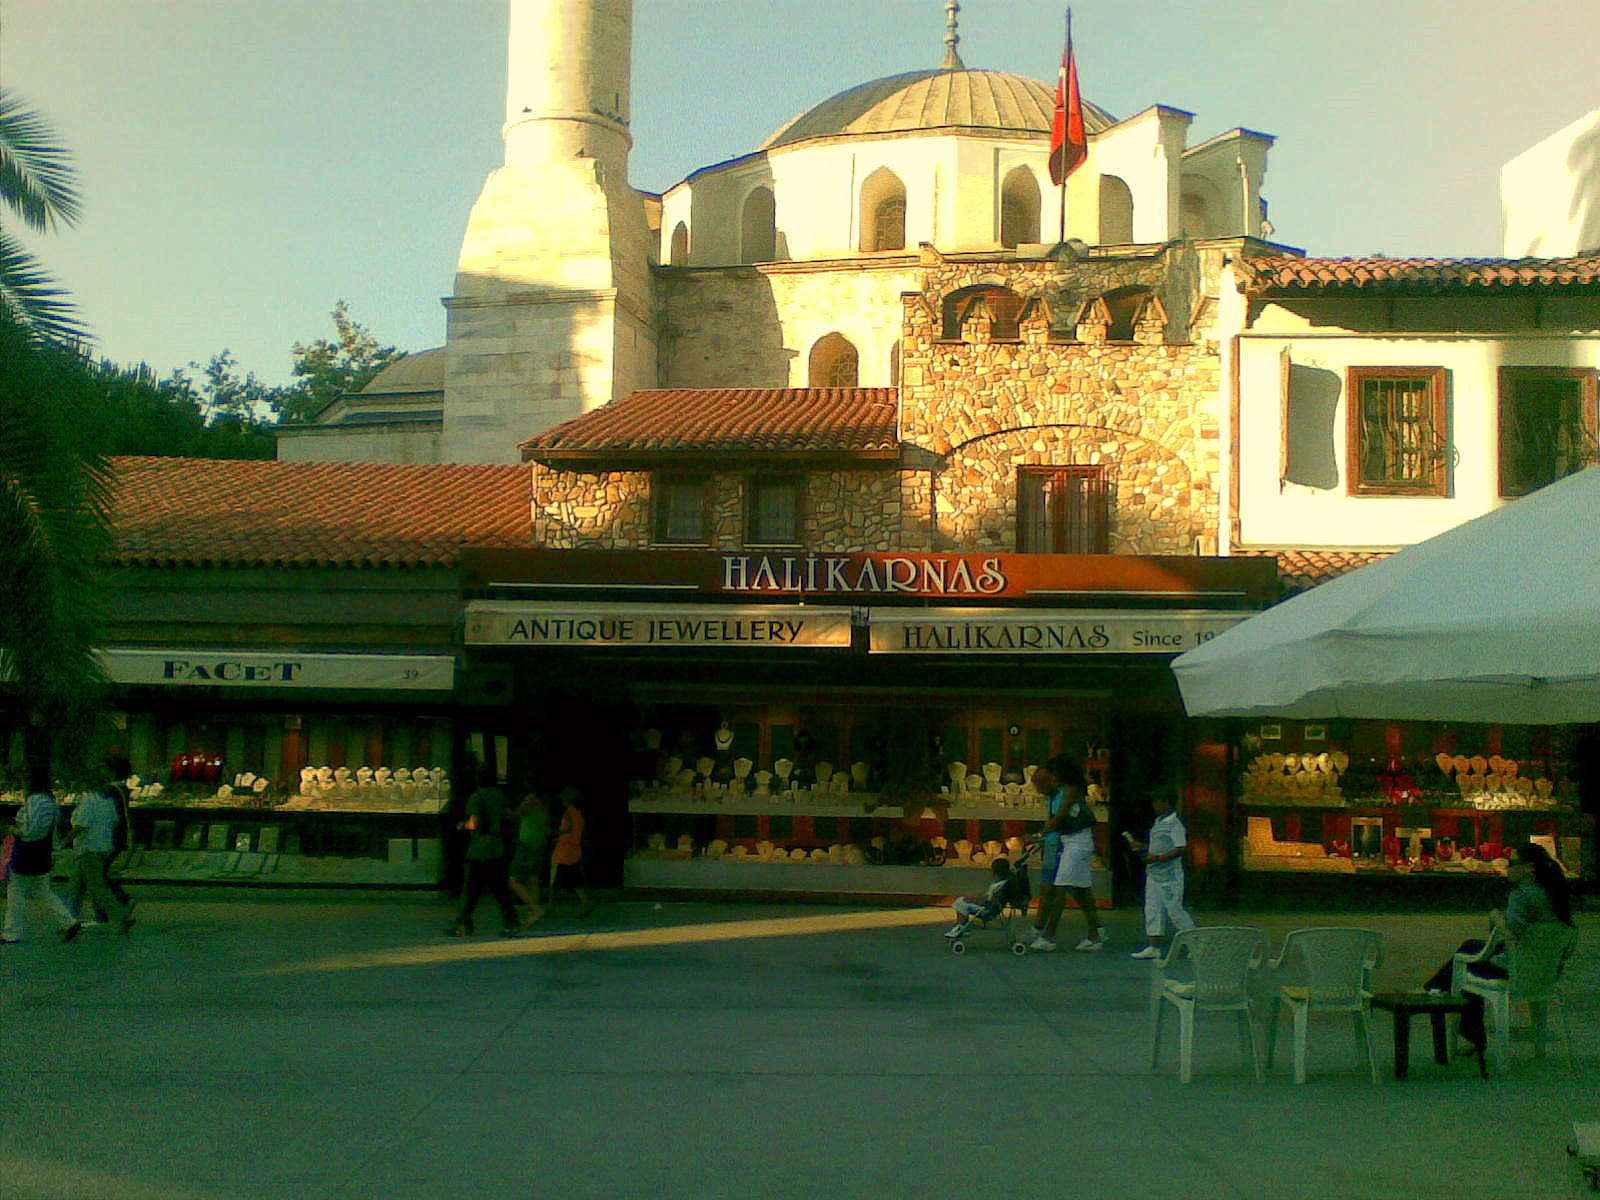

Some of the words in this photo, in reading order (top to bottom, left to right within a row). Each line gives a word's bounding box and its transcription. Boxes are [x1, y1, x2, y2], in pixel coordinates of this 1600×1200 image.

[721, 554, 1006, 594] HALİKARNAS
[509, 619, 634, 641] ANTIQUE
[647, 620, 805, 645] JEWELLERY
[903, 622, 1110, 650] HALİKARNAS
[1132, 630, 1183, 647] Since
[162, 660, 302, 681] FACET
